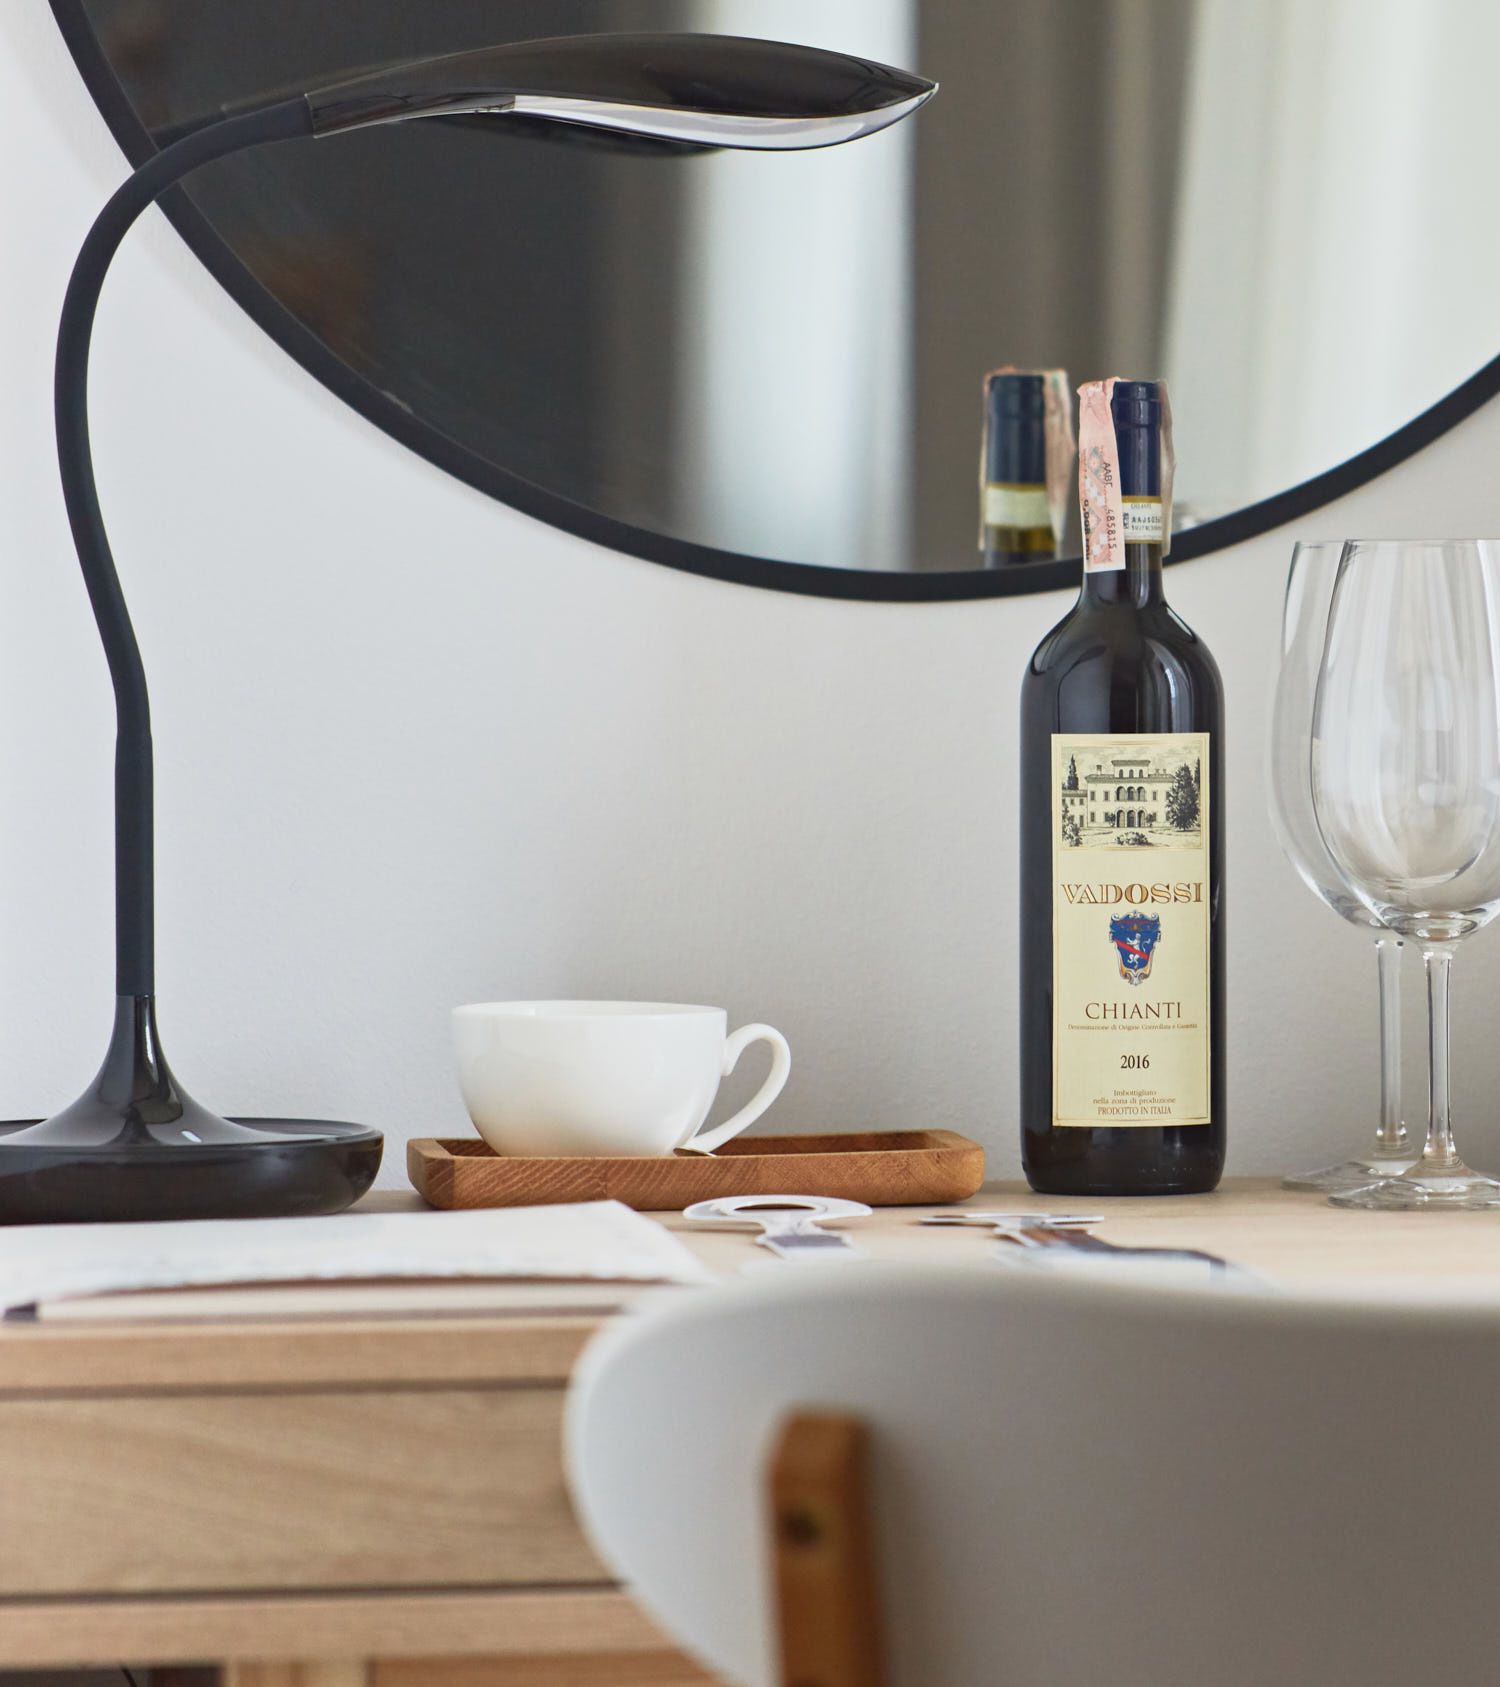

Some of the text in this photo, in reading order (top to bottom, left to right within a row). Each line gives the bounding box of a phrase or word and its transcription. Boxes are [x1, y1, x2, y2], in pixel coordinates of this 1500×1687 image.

[1061, 882, 1204, 905] VADOSSI
[1085, 1001, 1182, 1020] CHIANTI
[1120, 1054, 1150, 1069] 2016
[1097, 1106, 1172, 1115] PRODOTTO IN ITALIA
